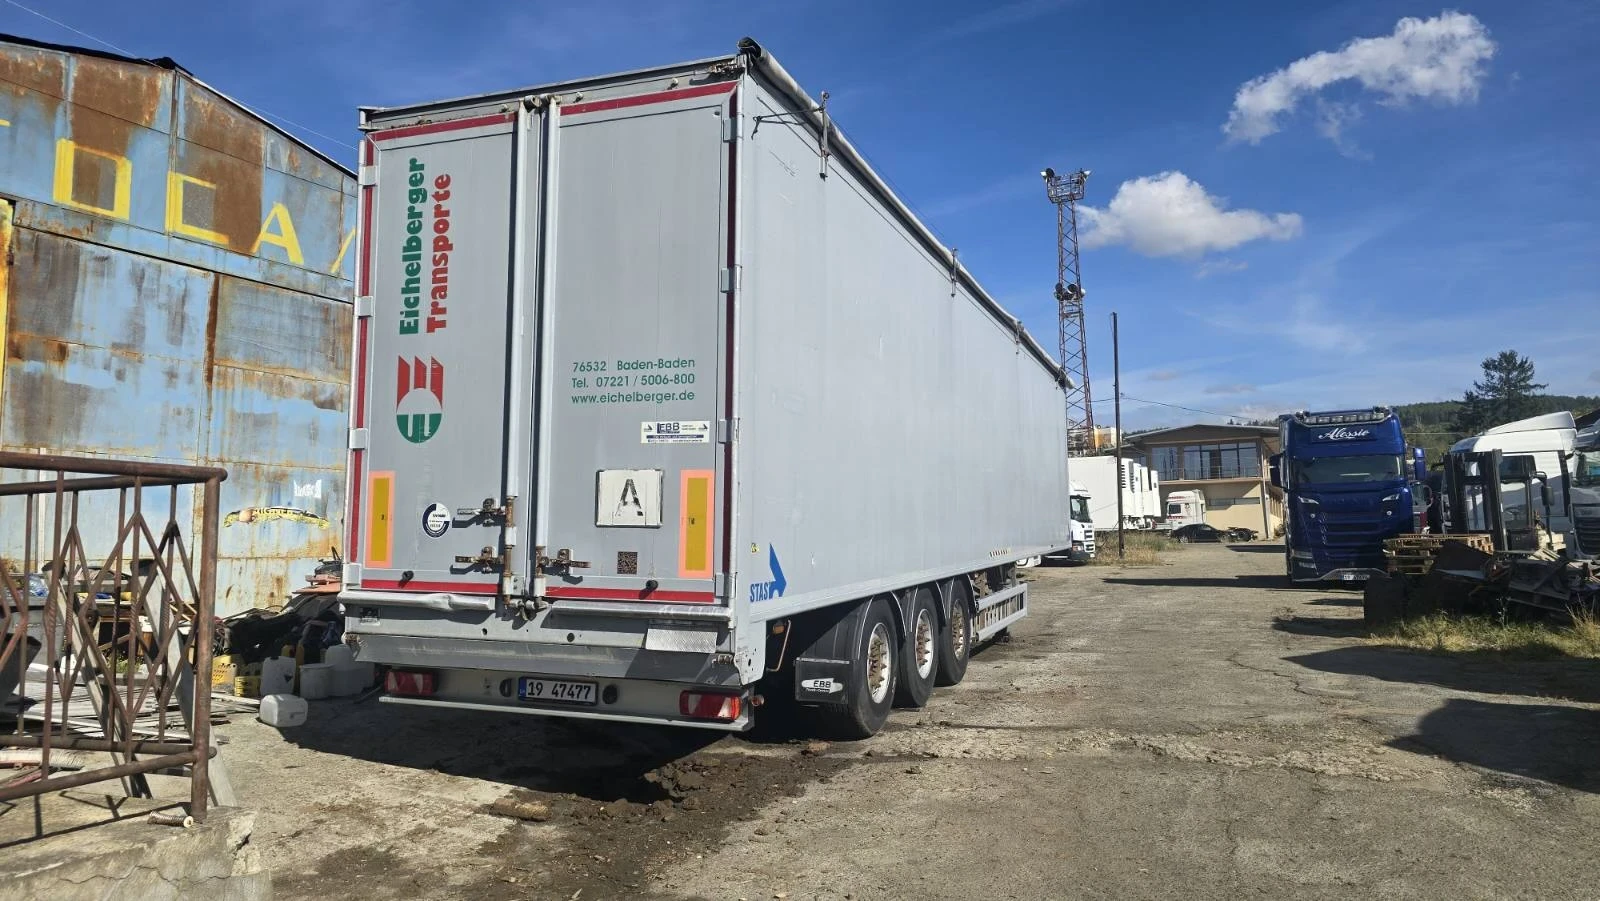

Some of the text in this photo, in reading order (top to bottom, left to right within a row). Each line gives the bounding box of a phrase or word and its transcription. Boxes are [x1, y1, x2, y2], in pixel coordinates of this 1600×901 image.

[400, 157, 428, 335] Eichelberger
[427, 173, 454, 334] Transporte
[573, 358, 695, 372] 76532 Baden-Baden
[572, 377, 589, 388] Tel.
[596, 375, 629, 387] 07221
[641, 373, 695, 386] 5006-800
[571, 390, 695, 404] www.eichelberger.de
[1319, 427, 1370, 440] Alessio
[615, 478, 644, 517] A
[750, 581, 769, 603] STAS
[528, 681, 592, 700] 19 47477
[813, 680, 832, 688] EBB
